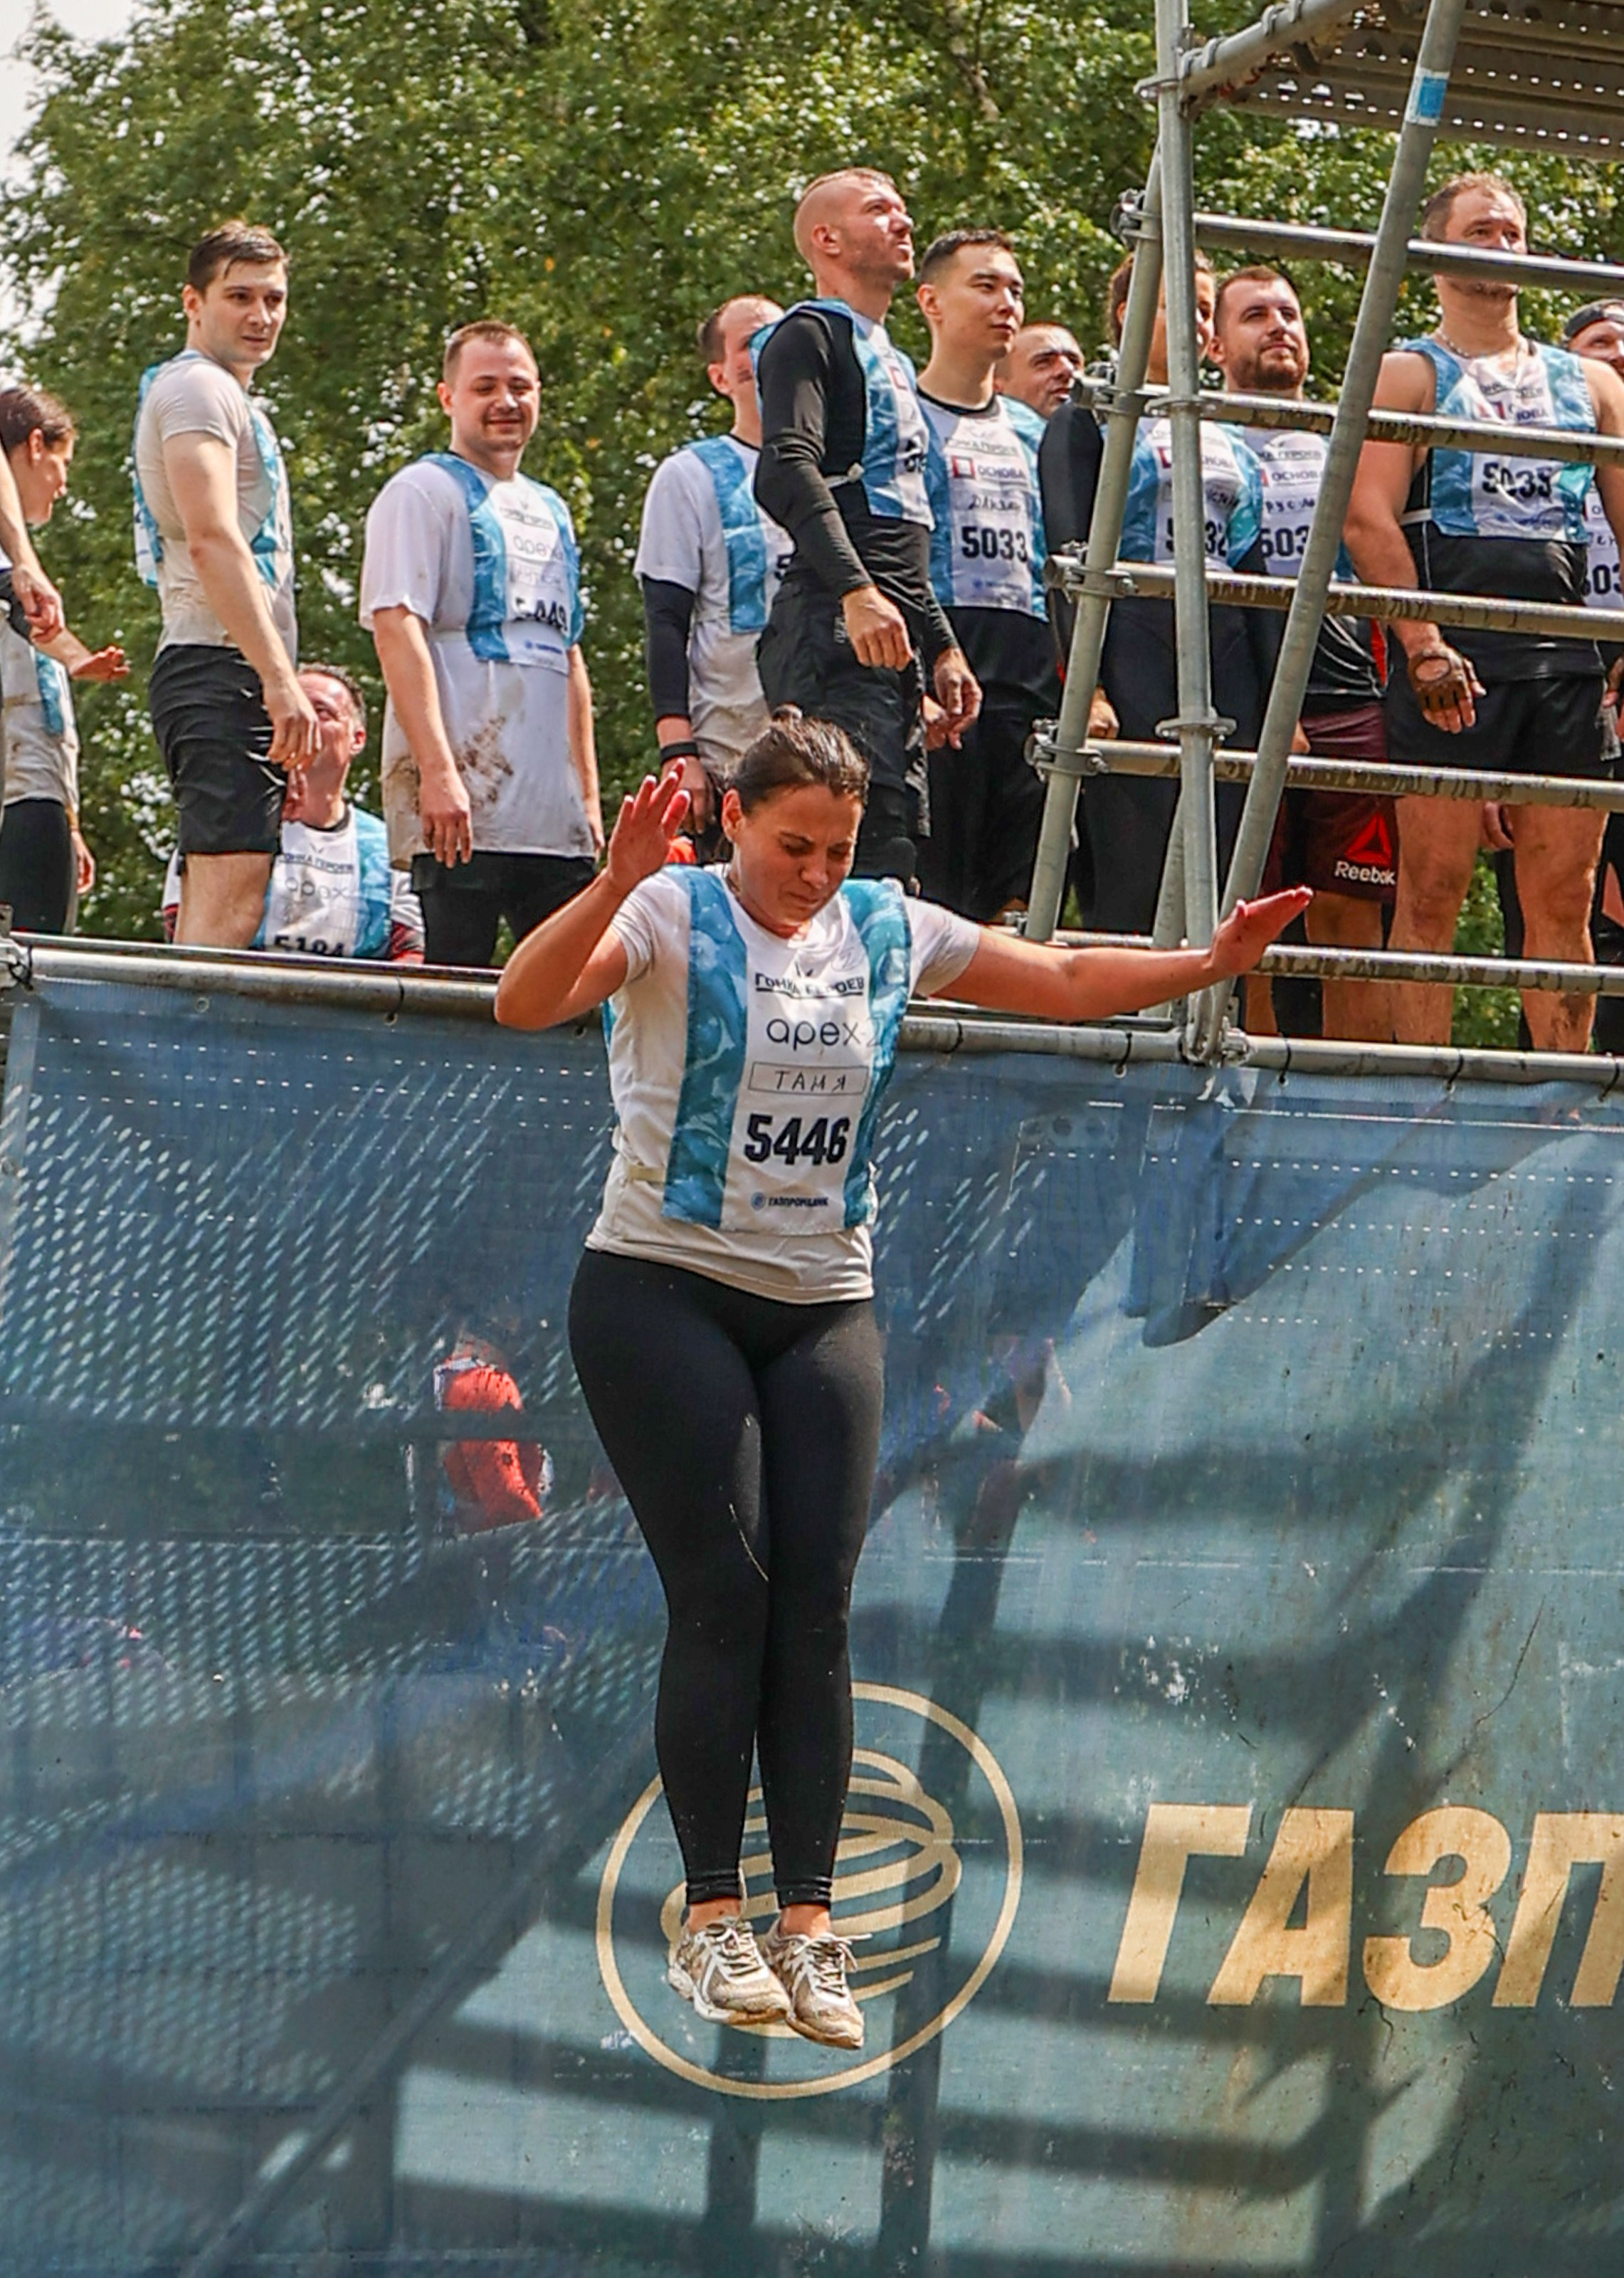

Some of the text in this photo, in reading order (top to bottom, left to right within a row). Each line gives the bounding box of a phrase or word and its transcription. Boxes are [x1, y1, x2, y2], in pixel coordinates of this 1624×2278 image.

[961, 525, 1028, 563] 5033
[1334, 860, 1396, 886] Reebok
[766, 1018, 863, 1051] apex
[774, 1070, 847, 1092] ТАНЯ
[744, 1113, 851, 1167] 5446
[1107, 1802, 1624, 2012] ГАЗП
